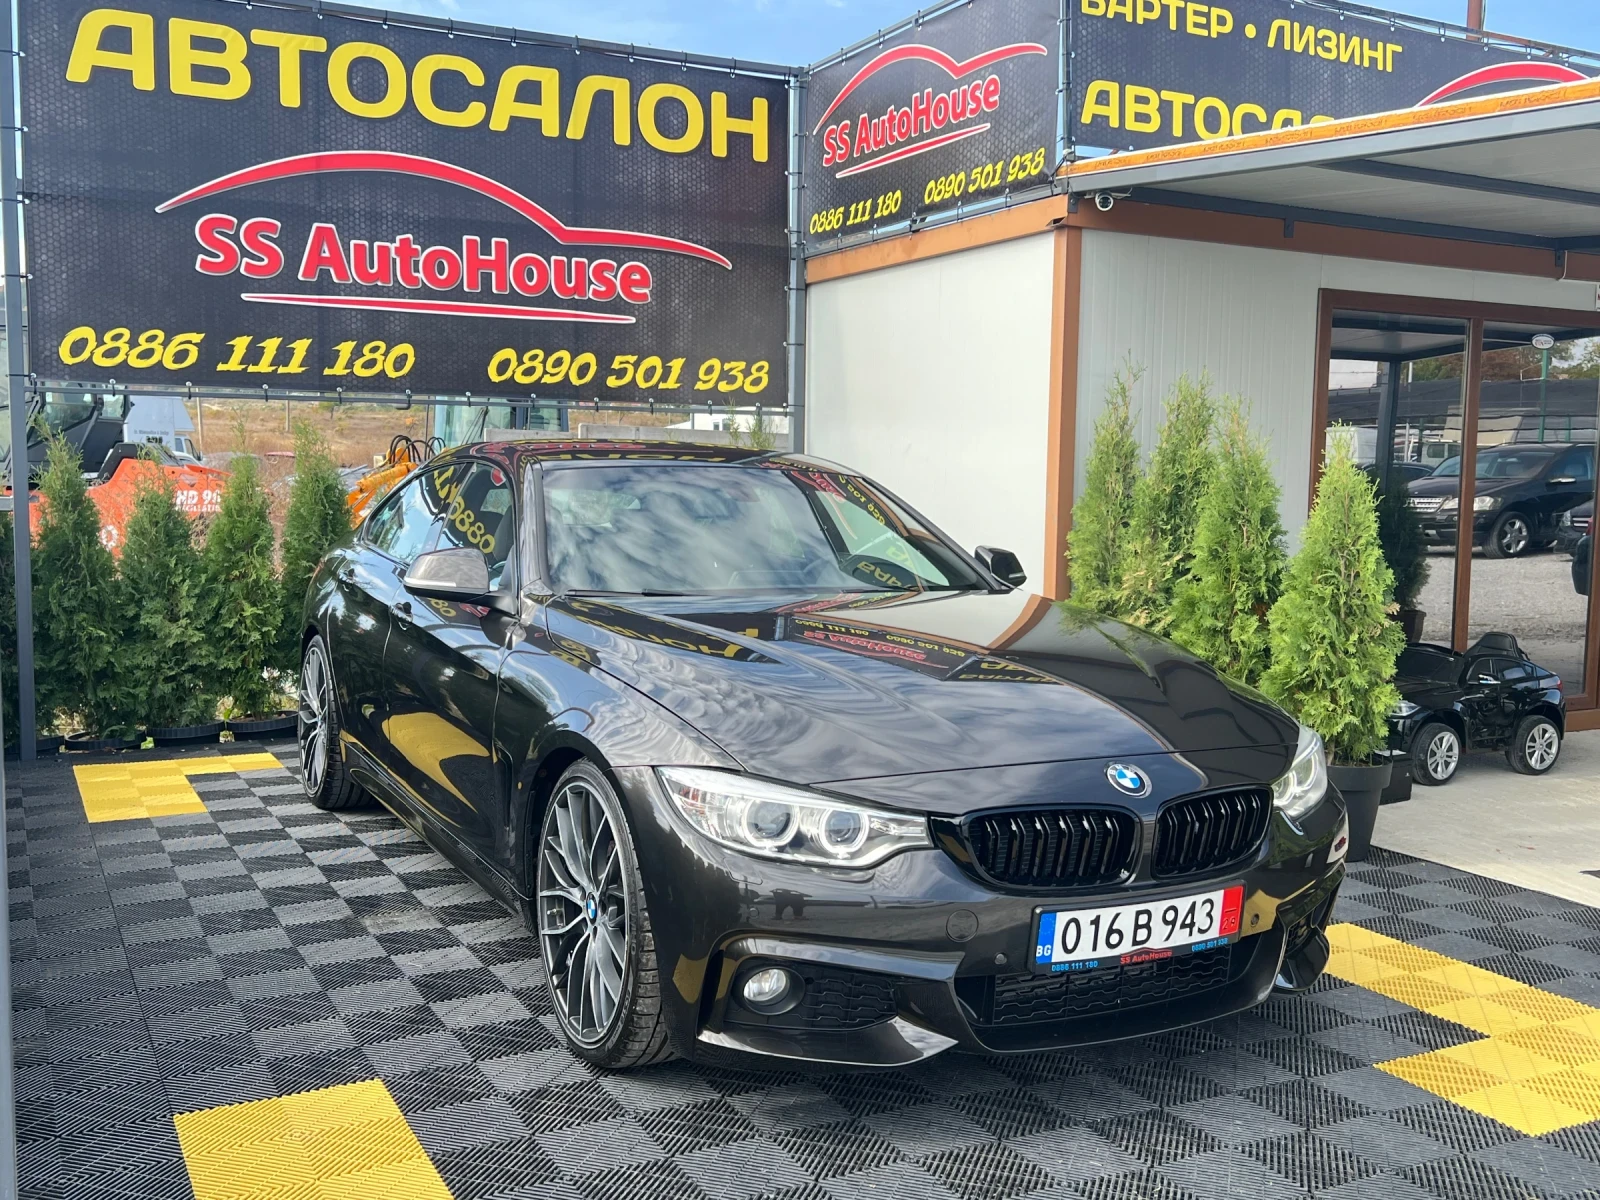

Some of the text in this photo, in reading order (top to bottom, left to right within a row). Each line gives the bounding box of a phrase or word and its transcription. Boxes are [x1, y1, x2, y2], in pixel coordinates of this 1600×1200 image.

[1267, 18, 1403, 73] ЛИЗИНГ
[67, 9, 769, 164] АВТОСАЛОН
[1080, 80, 1334, 141] АВТОС
[822, 74, 1001, 167] SS AutoHouse
[809, 147, 1046, 235] 0886 111 180 0890 501 938
[194, 213, 653, 305] SS AutoHouse
[59, 327, 770, 394] 0886 111 180 0890 501 938
[176, 489, 199, 505] HD
[1036, 944, 1052, 957] BG
[1120, 951, 1173, 965] SS AutoHouse
